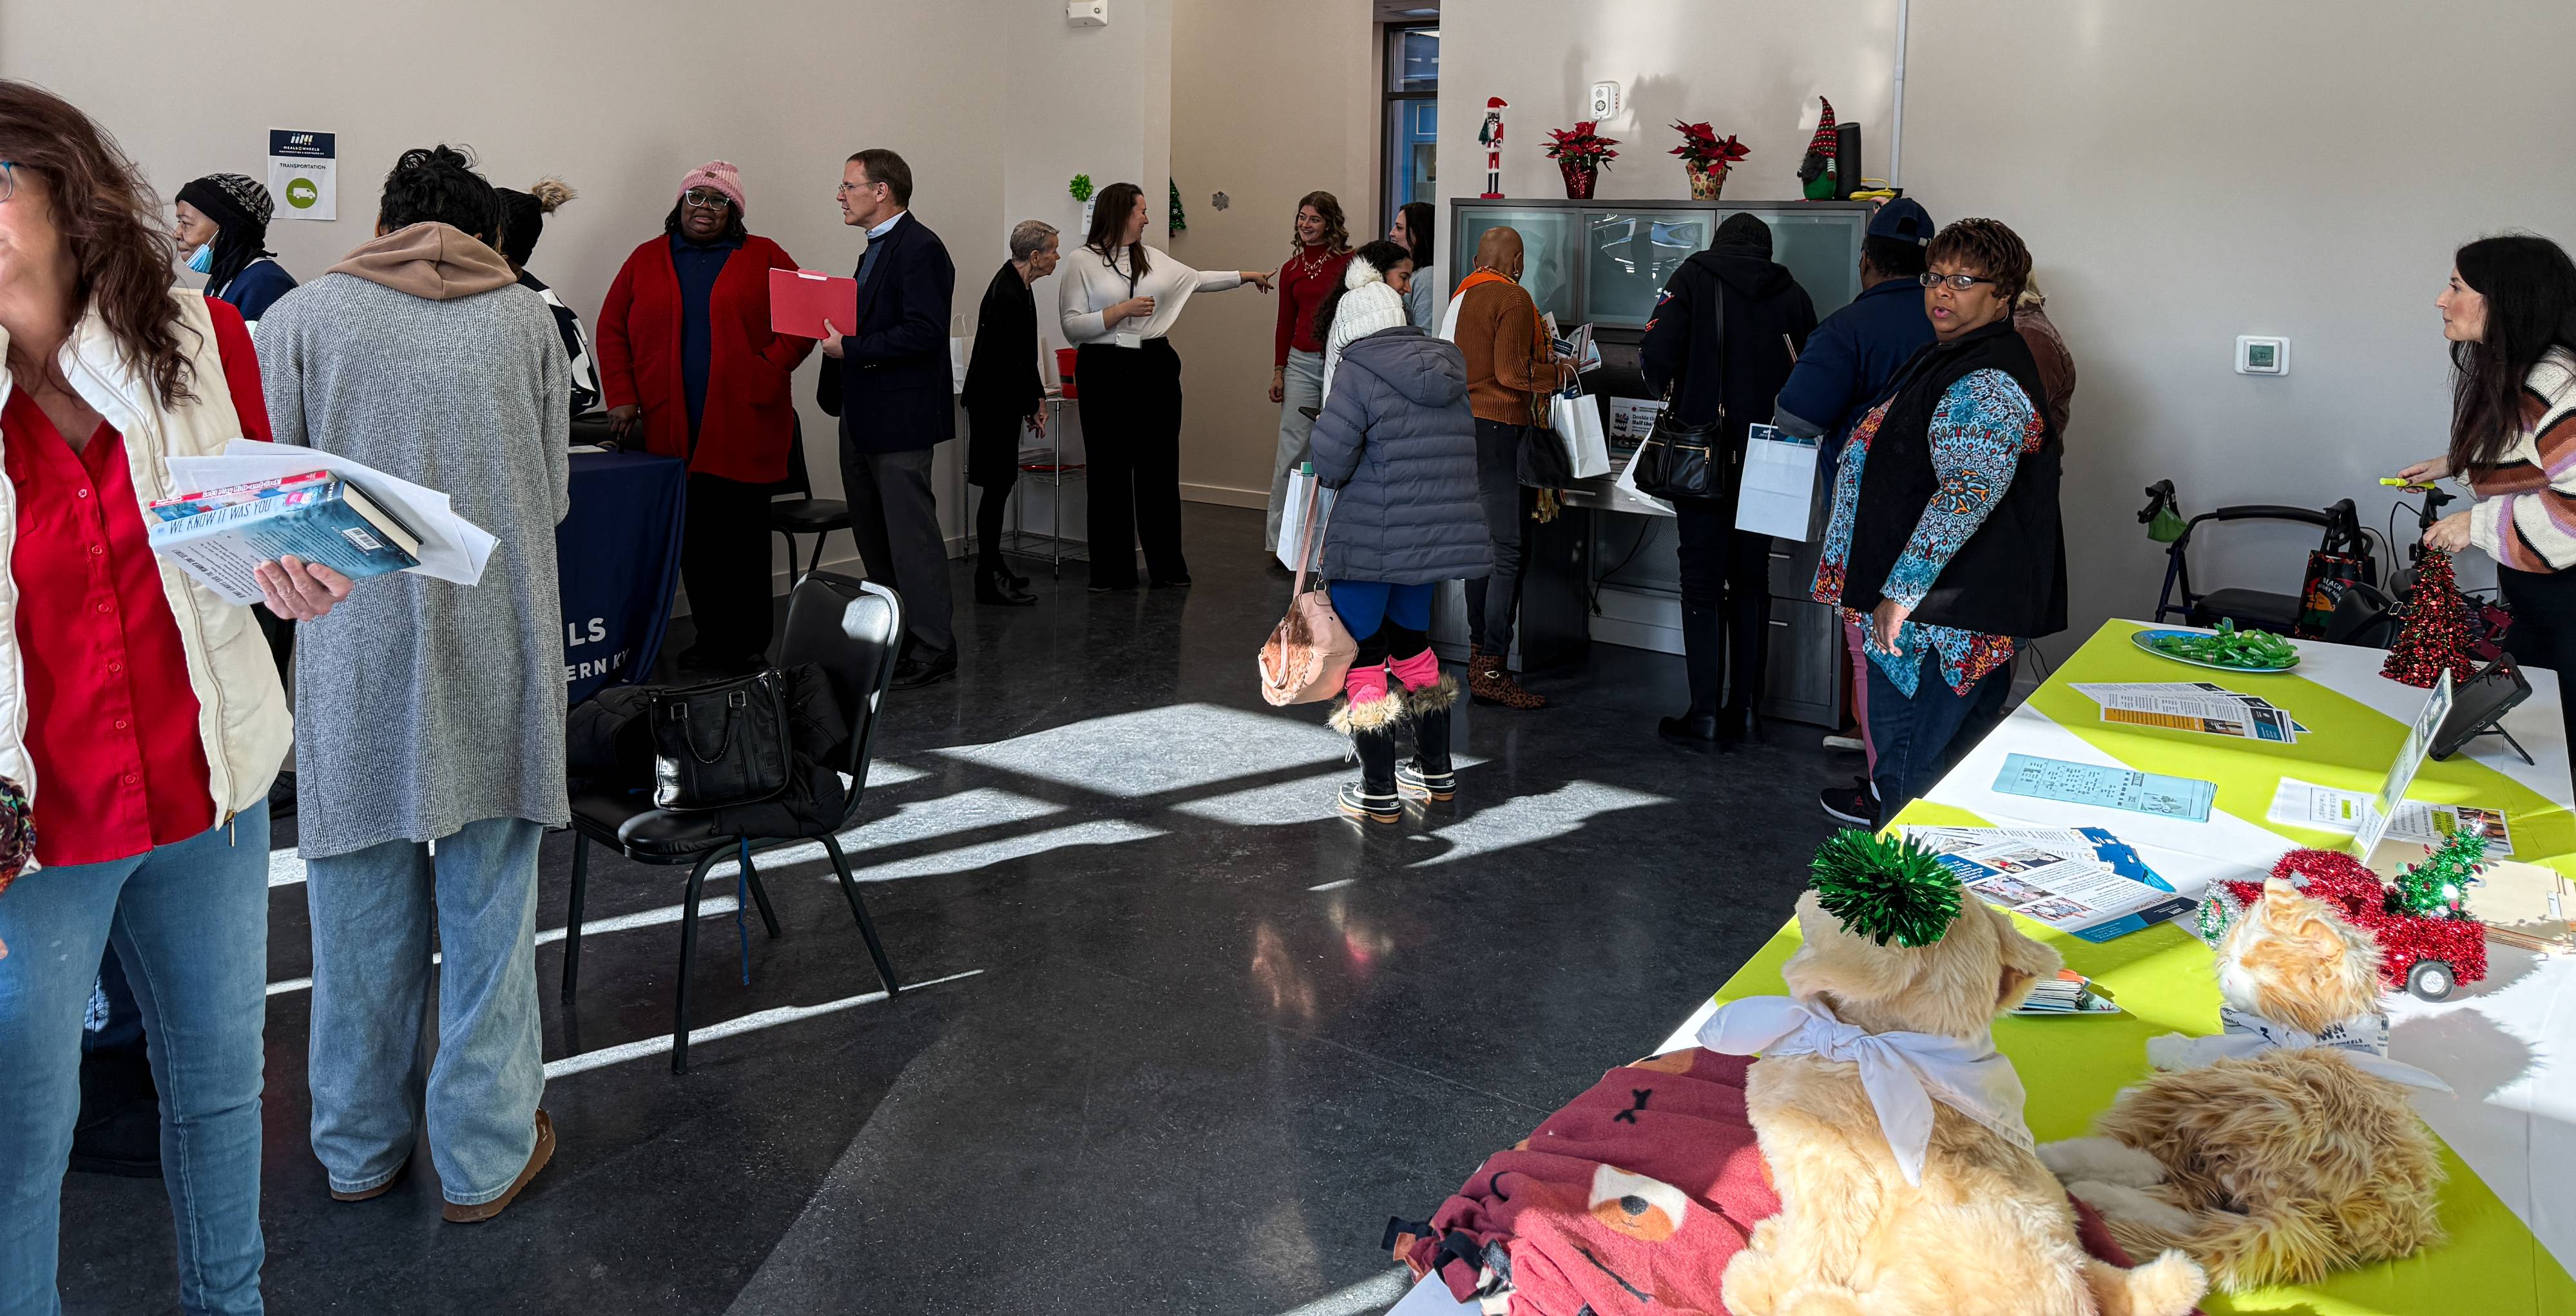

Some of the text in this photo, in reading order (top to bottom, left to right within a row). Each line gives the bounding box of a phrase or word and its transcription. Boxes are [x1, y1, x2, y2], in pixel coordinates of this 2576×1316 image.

[170, 499, 272, 534] WE KNOW IT WAS YOU
[569, 618, 606, 647] LS
[565, 648, 630, 682] ERN KY
